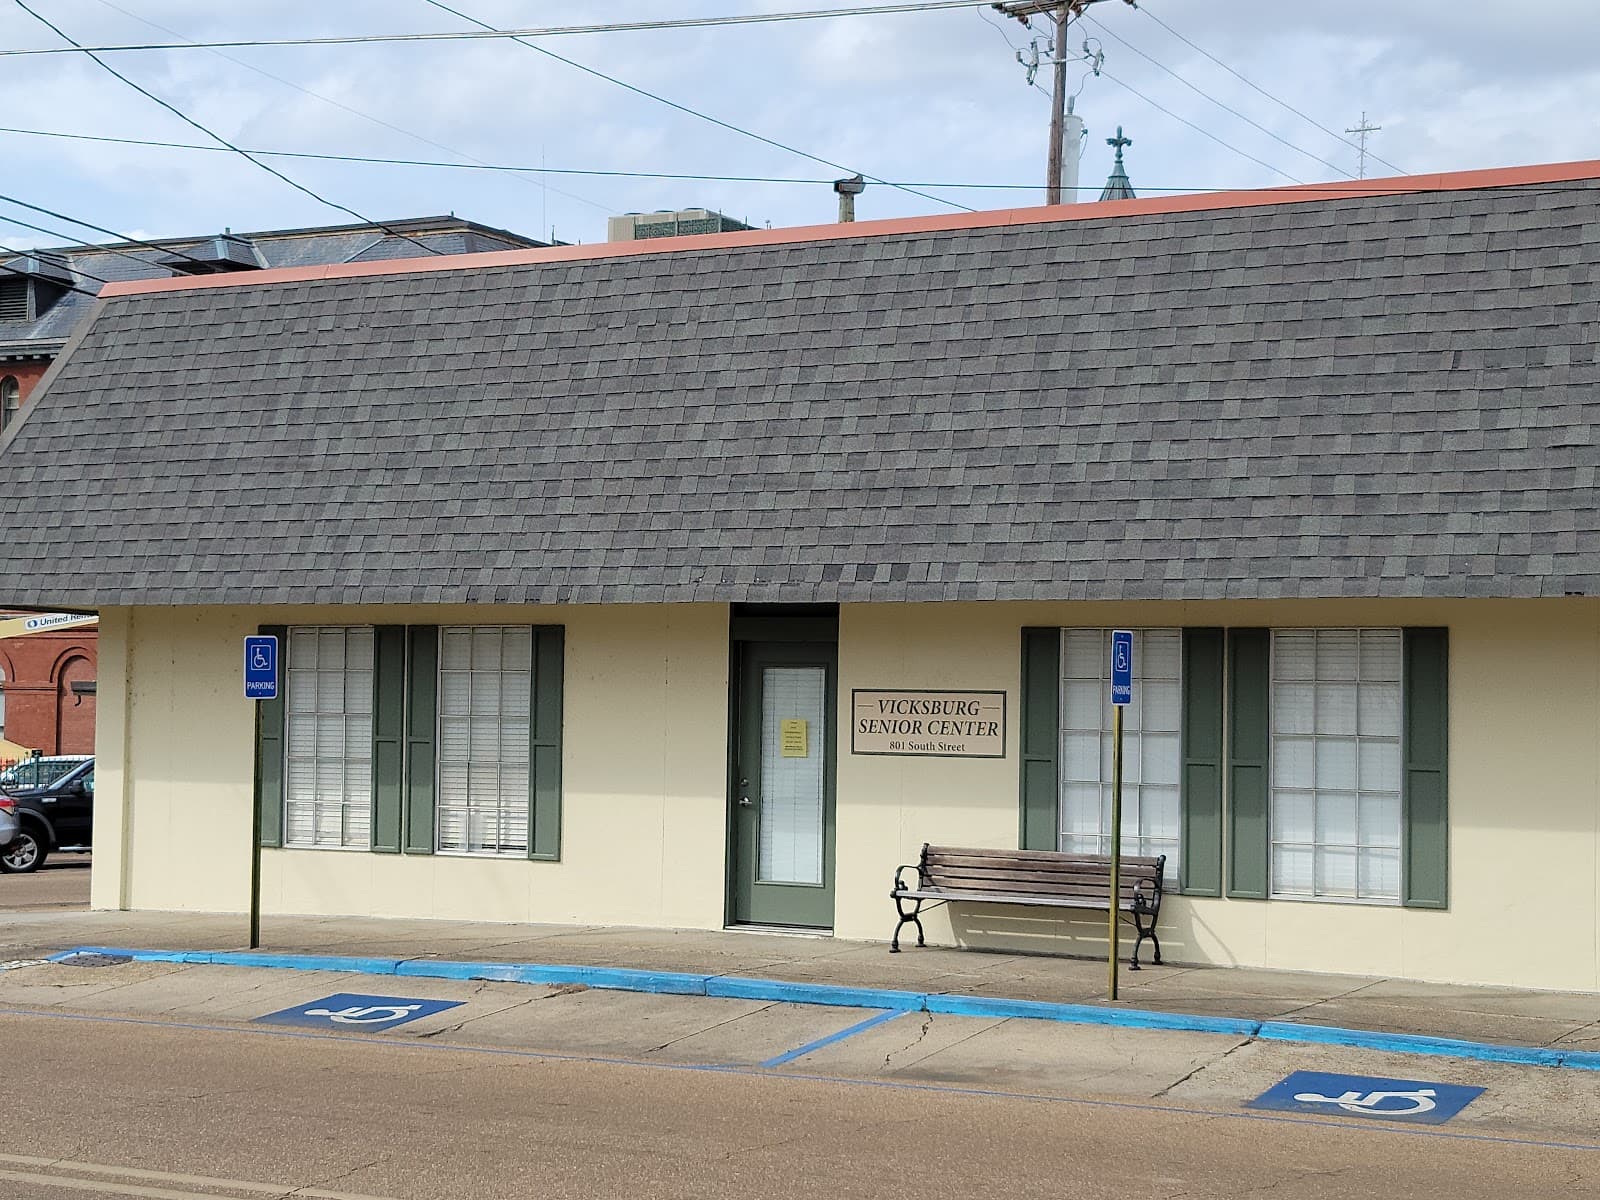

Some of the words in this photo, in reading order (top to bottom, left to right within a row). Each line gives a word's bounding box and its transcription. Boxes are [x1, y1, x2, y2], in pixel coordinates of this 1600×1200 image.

[40, 615, 69, 626] United
[247, 681, 275, 690] PARKING
[1112, 685, 1130, 695] PARKING
[877, 699, 980, 715] VICKSBURG
[858, 718, 923, 735] SENIOR
[927, 720, 998, 737] CENTER
[889, 740, 905, 750] 801
[908, 741, 936, 751] South
[937, 741, 966, 752] Street
